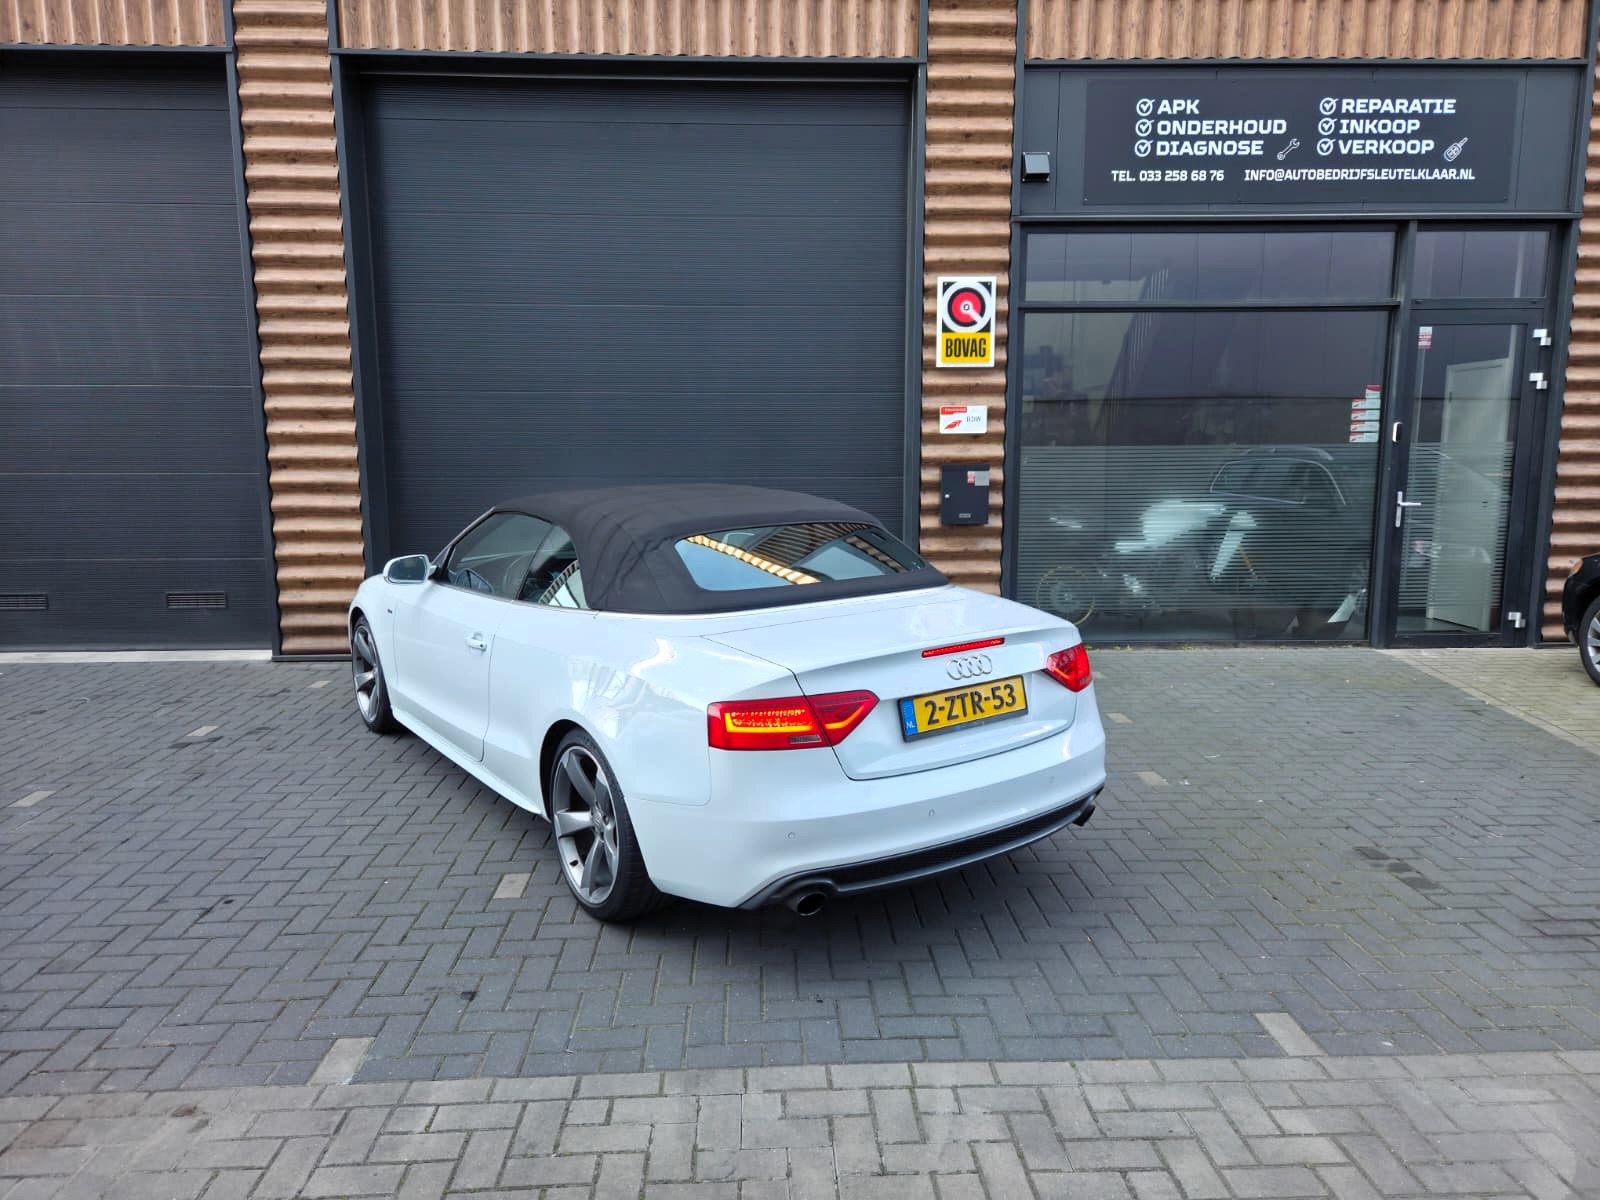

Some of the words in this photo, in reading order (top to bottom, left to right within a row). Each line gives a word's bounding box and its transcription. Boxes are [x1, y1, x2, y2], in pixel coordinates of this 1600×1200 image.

[1157, 99, 1200, 115] APK
[1341, 98, 1456, 114] REPARATIE
[1157, 119, 1287, 136] ONDERHOUD
[1339, 118, 1421, 135] INKOOP
[1156, 139, 1264, 156] DIAGNOSE
[1338, 139, 1435, 155] VERKOOP
[1111, 170, 1137, 182] TEL.
[1139, 170, 1162, 182] 033
[1164, 170, 1188, 181] 258
[1190, 169, 1207, 181] 68
[1209, 169, 1225, 181] 76
[1244, 168, 1476, 182] INFO@AUTOBEDRIJFSLEUTELKLAAR.NL
[945, 338, 987, 358] BOVAG
[924, 684, 1017, 726] 2-ZTR-53
